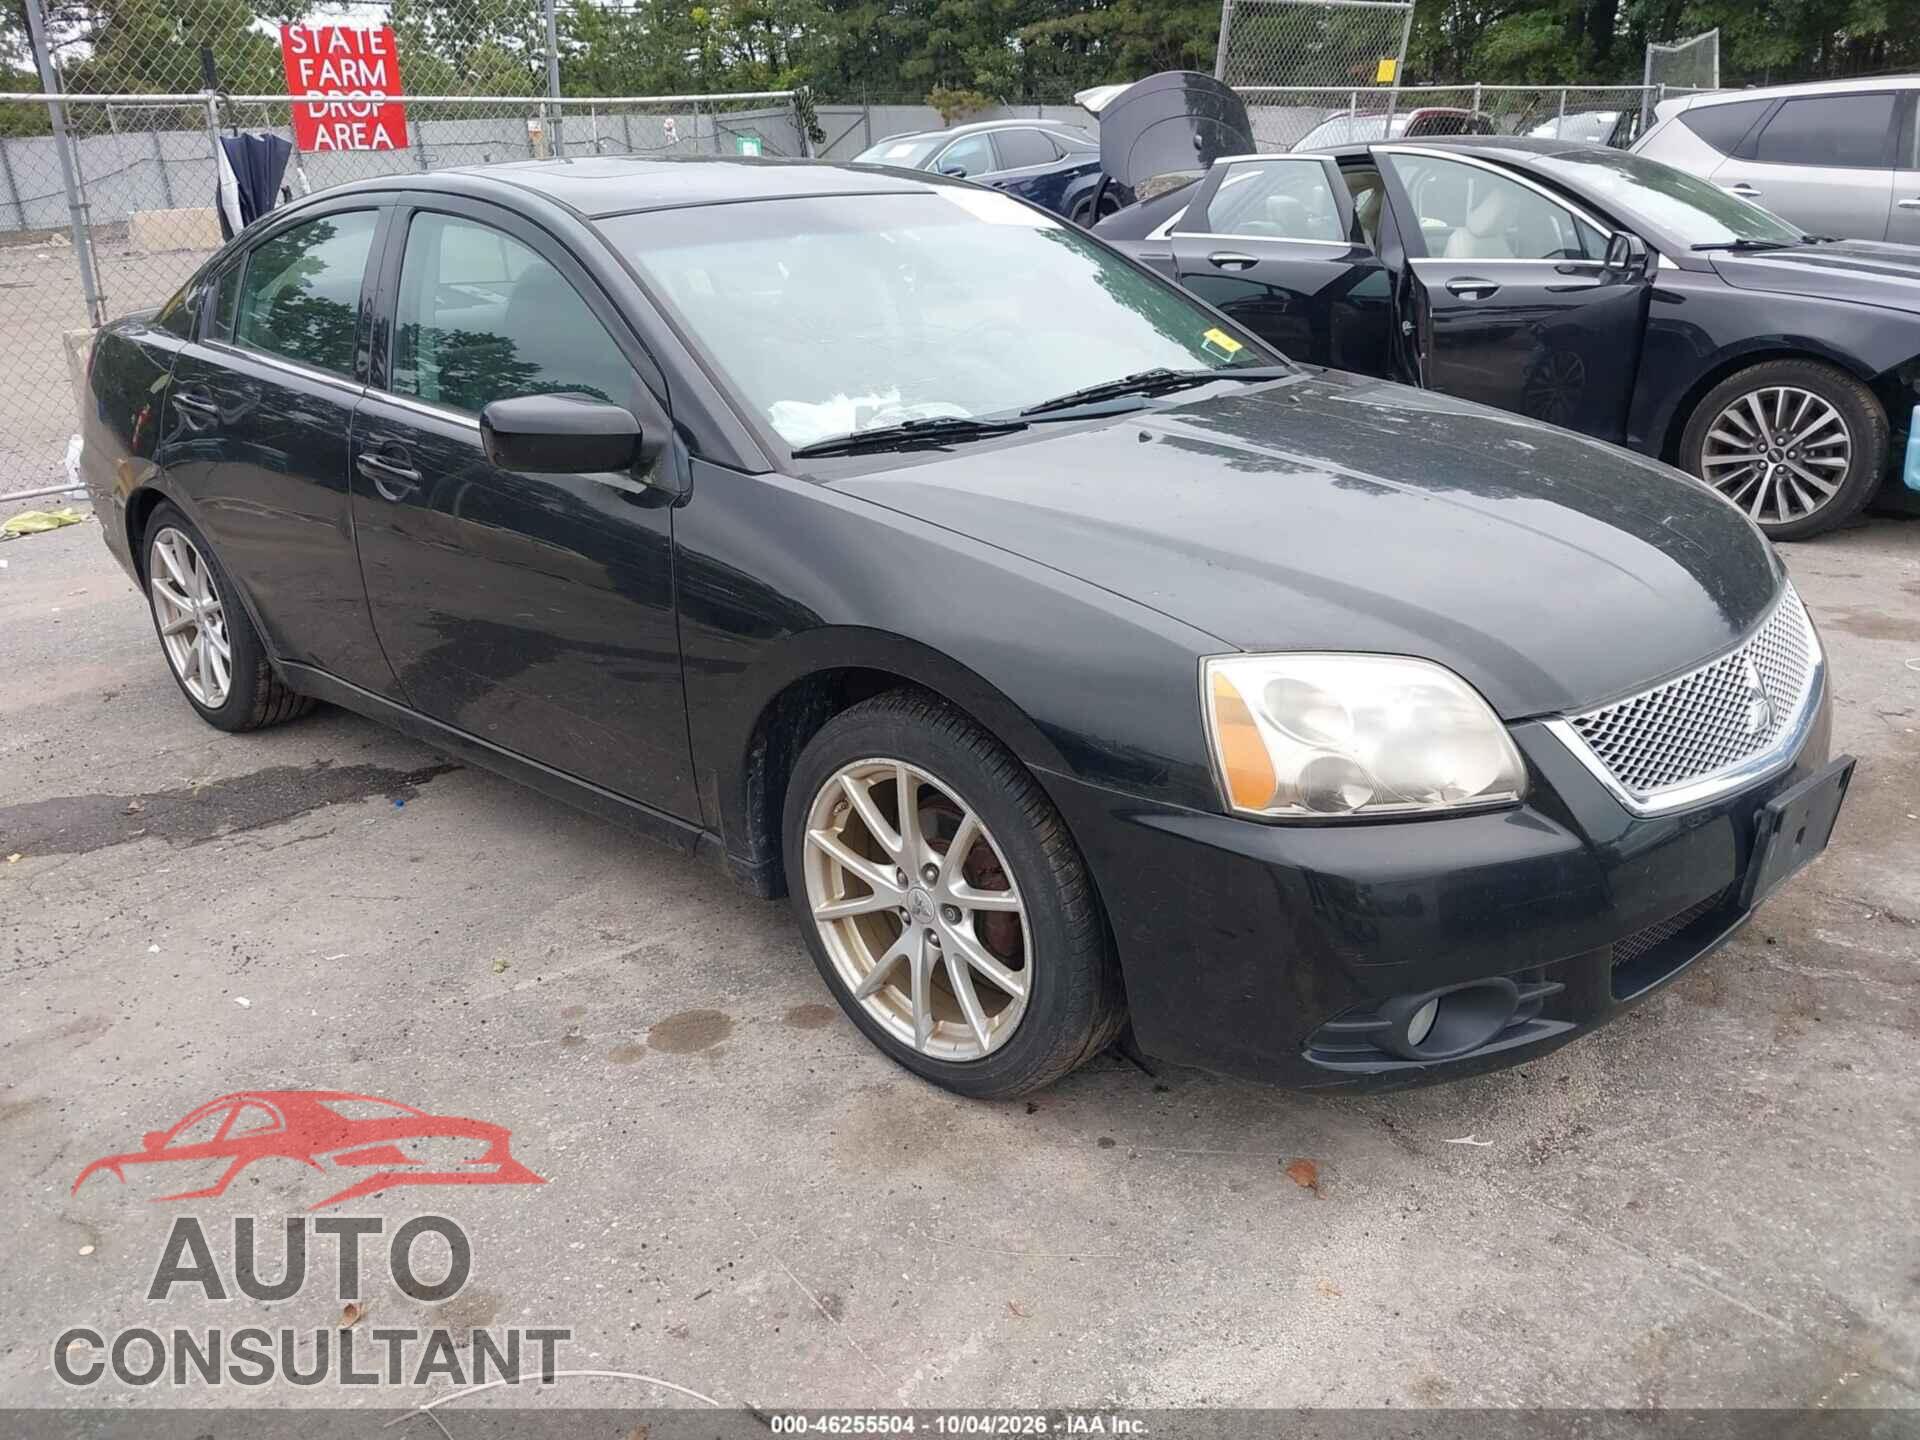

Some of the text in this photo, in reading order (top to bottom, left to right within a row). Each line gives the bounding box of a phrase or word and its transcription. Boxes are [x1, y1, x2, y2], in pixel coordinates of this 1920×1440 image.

[289, 26, 387, 55] STATE
[299, 59, 387, 87] FARM
[306, 90, 387, 118] DROP
[314, 123, 394, 150] AREA
